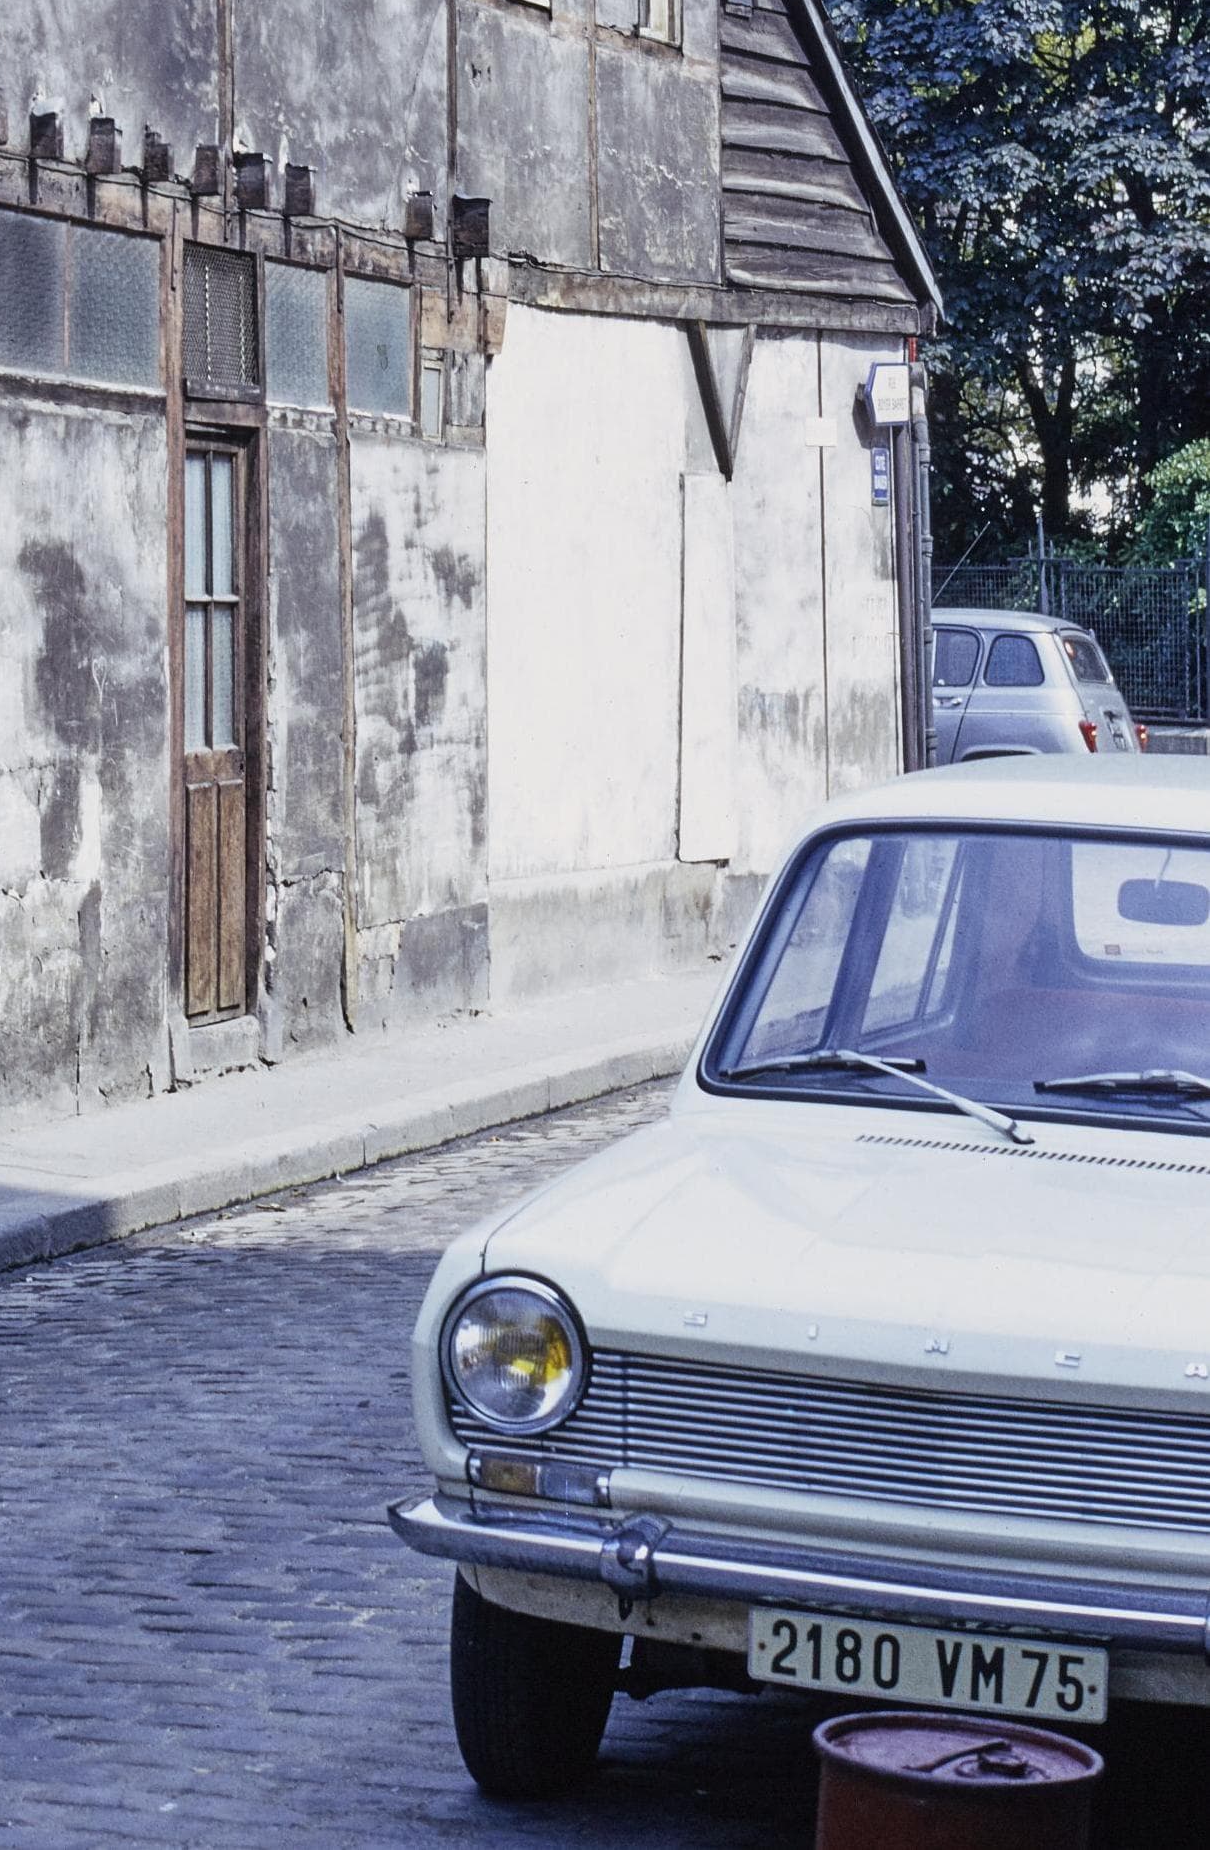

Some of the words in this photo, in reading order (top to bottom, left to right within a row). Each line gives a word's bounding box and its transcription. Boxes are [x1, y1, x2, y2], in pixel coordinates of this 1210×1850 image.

[683, 1310, 1208, 1380] SIMCA
[770, 1619, 901, 1690] 2180
[935, 1639, 1005, 1705] VM
[1021, 1651, 1085, 1712] 75
